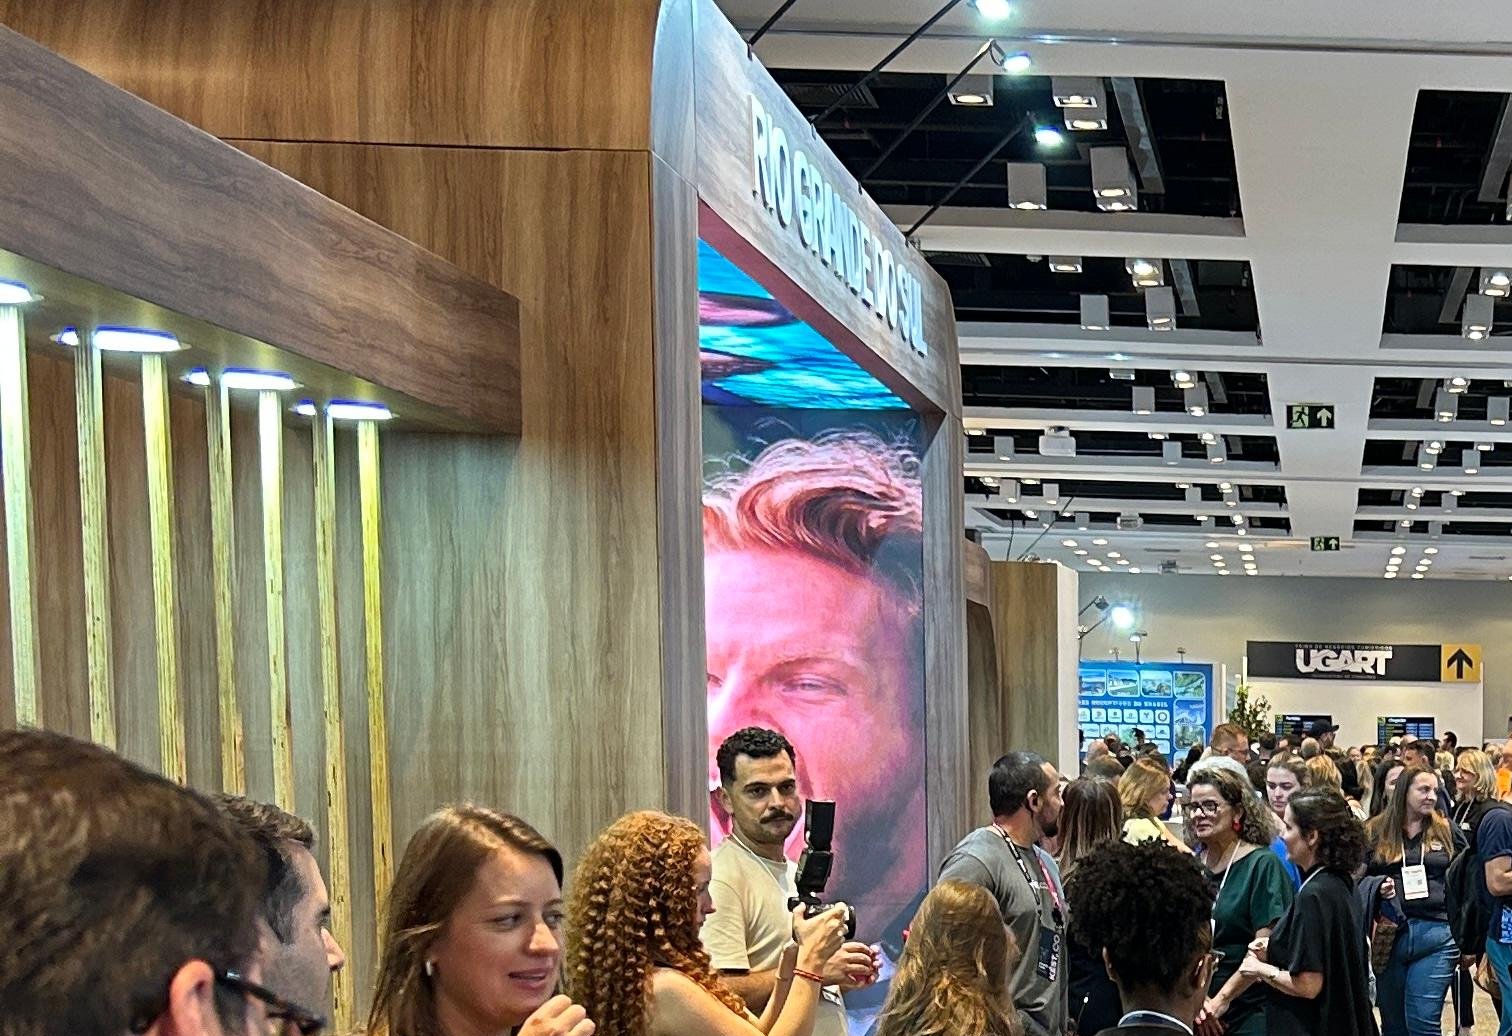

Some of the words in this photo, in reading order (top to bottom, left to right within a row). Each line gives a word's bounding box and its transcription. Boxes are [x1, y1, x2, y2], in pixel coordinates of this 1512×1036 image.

[749, 95, 792, 228] RIO
[793, 151, 874, 308] GRANDE
[872, 235, 898, 330] DO
[897, 264, 928, 357] SUL
[1296, 648, 1392, 676] UGART
